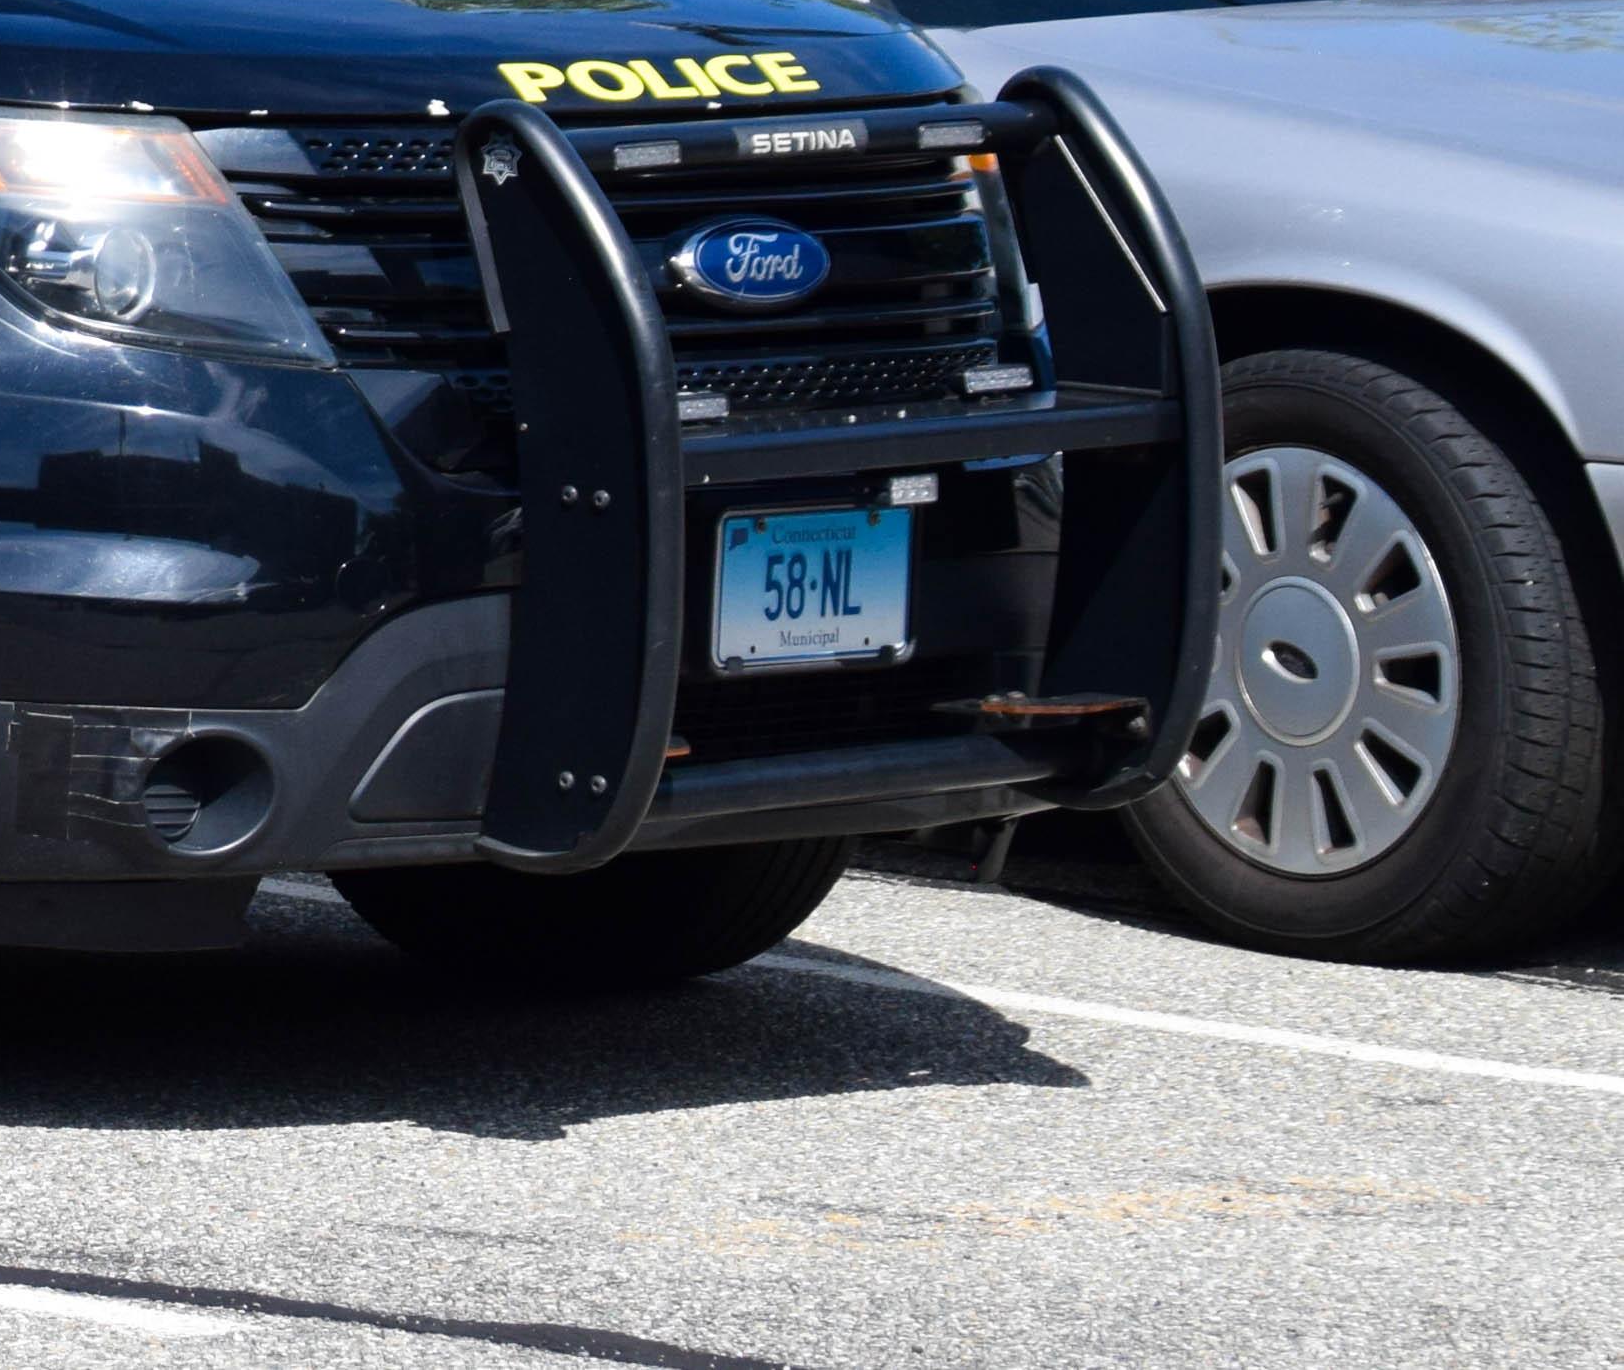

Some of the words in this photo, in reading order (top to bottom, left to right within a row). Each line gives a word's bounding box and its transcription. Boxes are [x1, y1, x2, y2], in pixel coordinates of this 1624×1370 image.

[498, 51, 821, 102] POLICE
[752, 129, 856, 156] SETINA
[725, 232, 804, 284] Ford
[779, 627, 841, 648] Municipal
